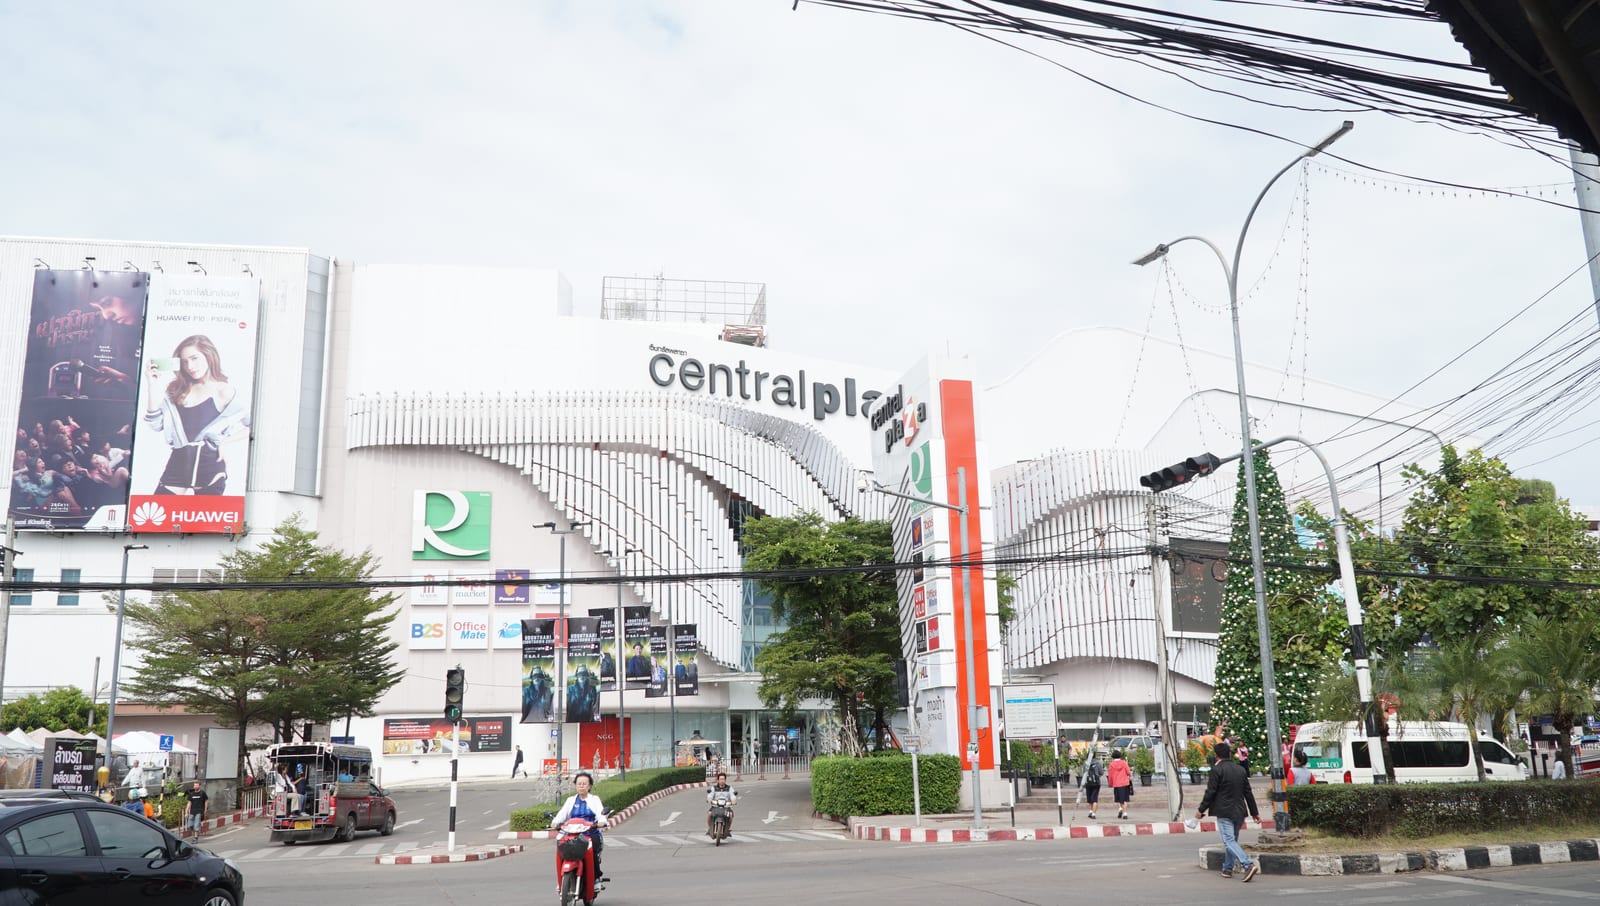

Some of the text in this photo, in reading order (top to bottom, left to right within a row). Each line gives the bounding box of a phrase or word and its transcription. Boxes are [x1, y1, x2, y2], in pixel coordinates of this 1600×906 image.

[871, 384, 903, 431] central
[171, 510, 239, 523] HUAWEI
[411, 489, 489, 556] R
[455, 590, 486, 598] market
[411, 623, 444, 638] B2S
[453, 621, 486, 631] Office
[460, 631, 486, 639] Mate
[55, 745, 83, 764] ล้างรถ
